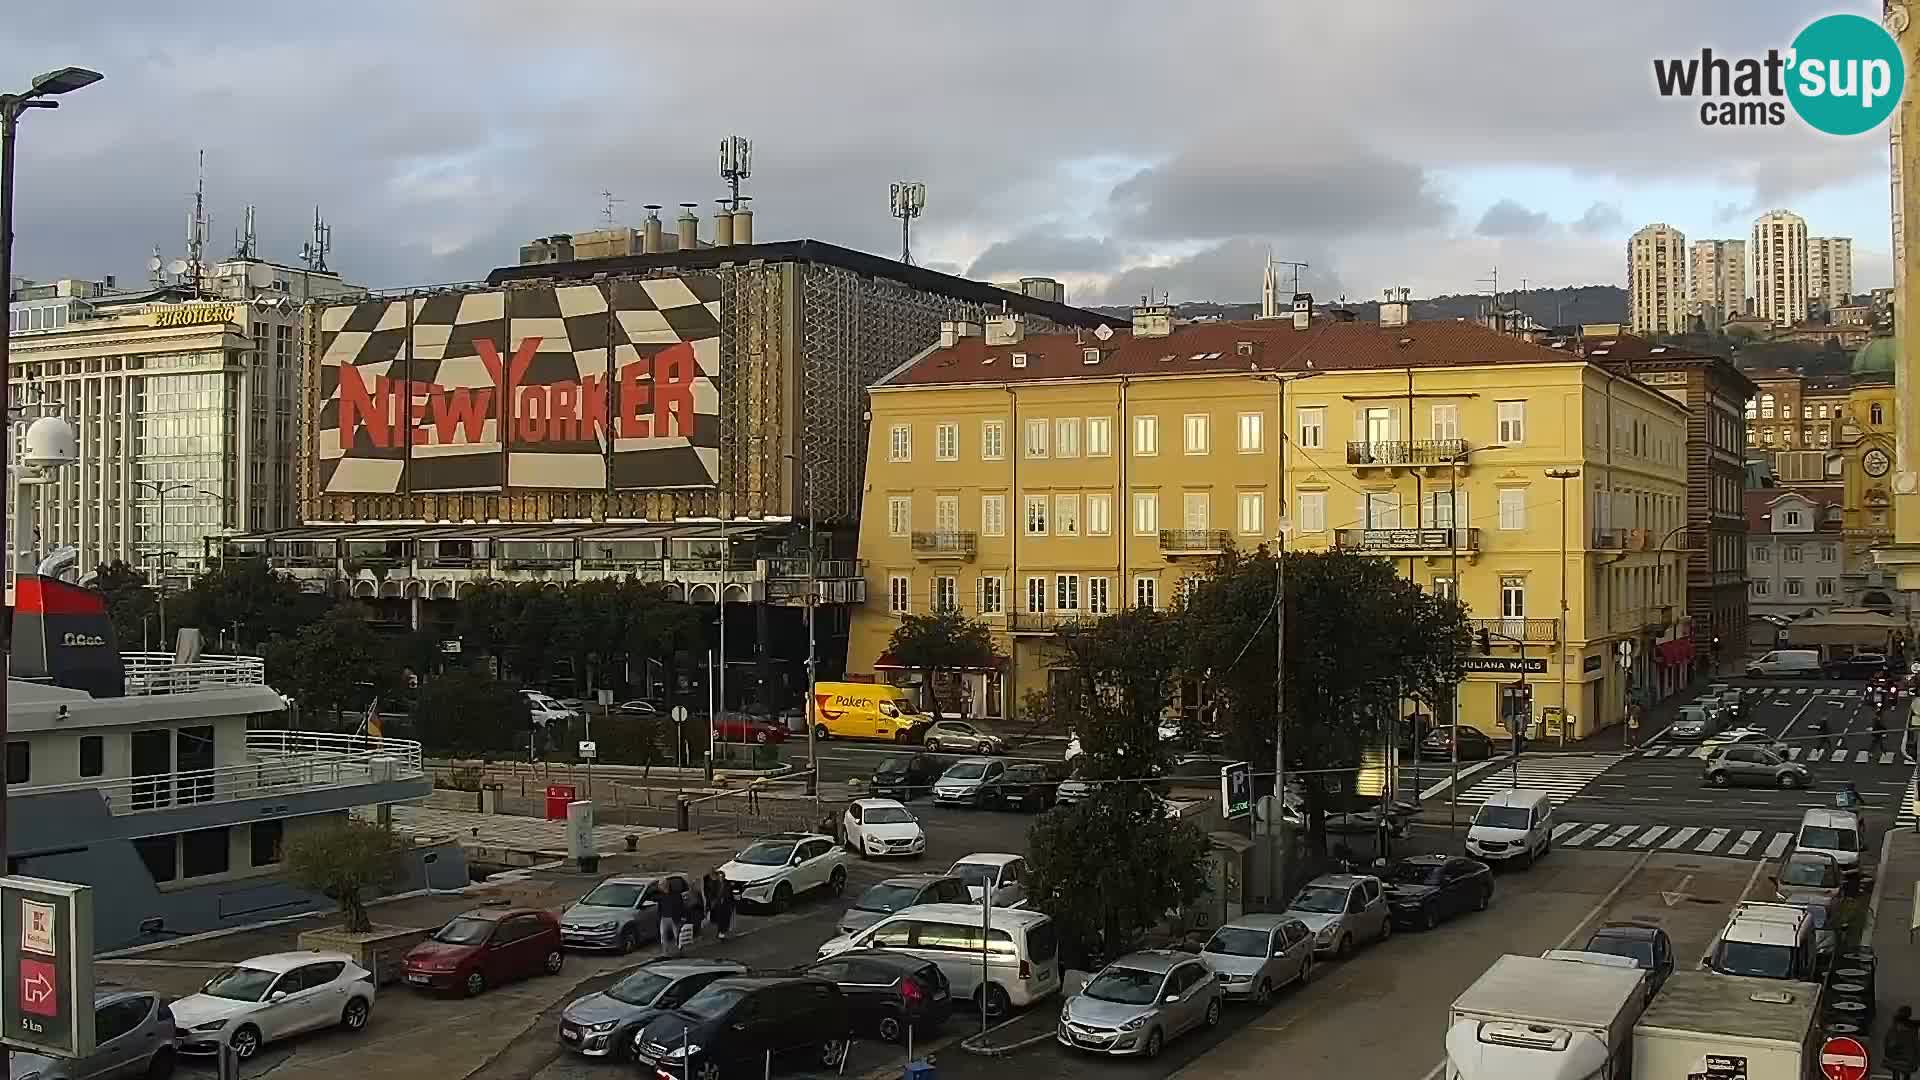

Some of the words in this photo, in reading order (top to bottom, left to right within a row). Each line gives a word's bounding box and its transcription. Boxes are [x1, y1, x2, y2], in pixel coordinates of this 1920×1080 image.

[1460, 661, 1505, 669] JULIANA
[1510, 662, 1541, 670] NAILS
[23, 1019, 28, 1030] 5
[30, 1020, 43, 1033] km
